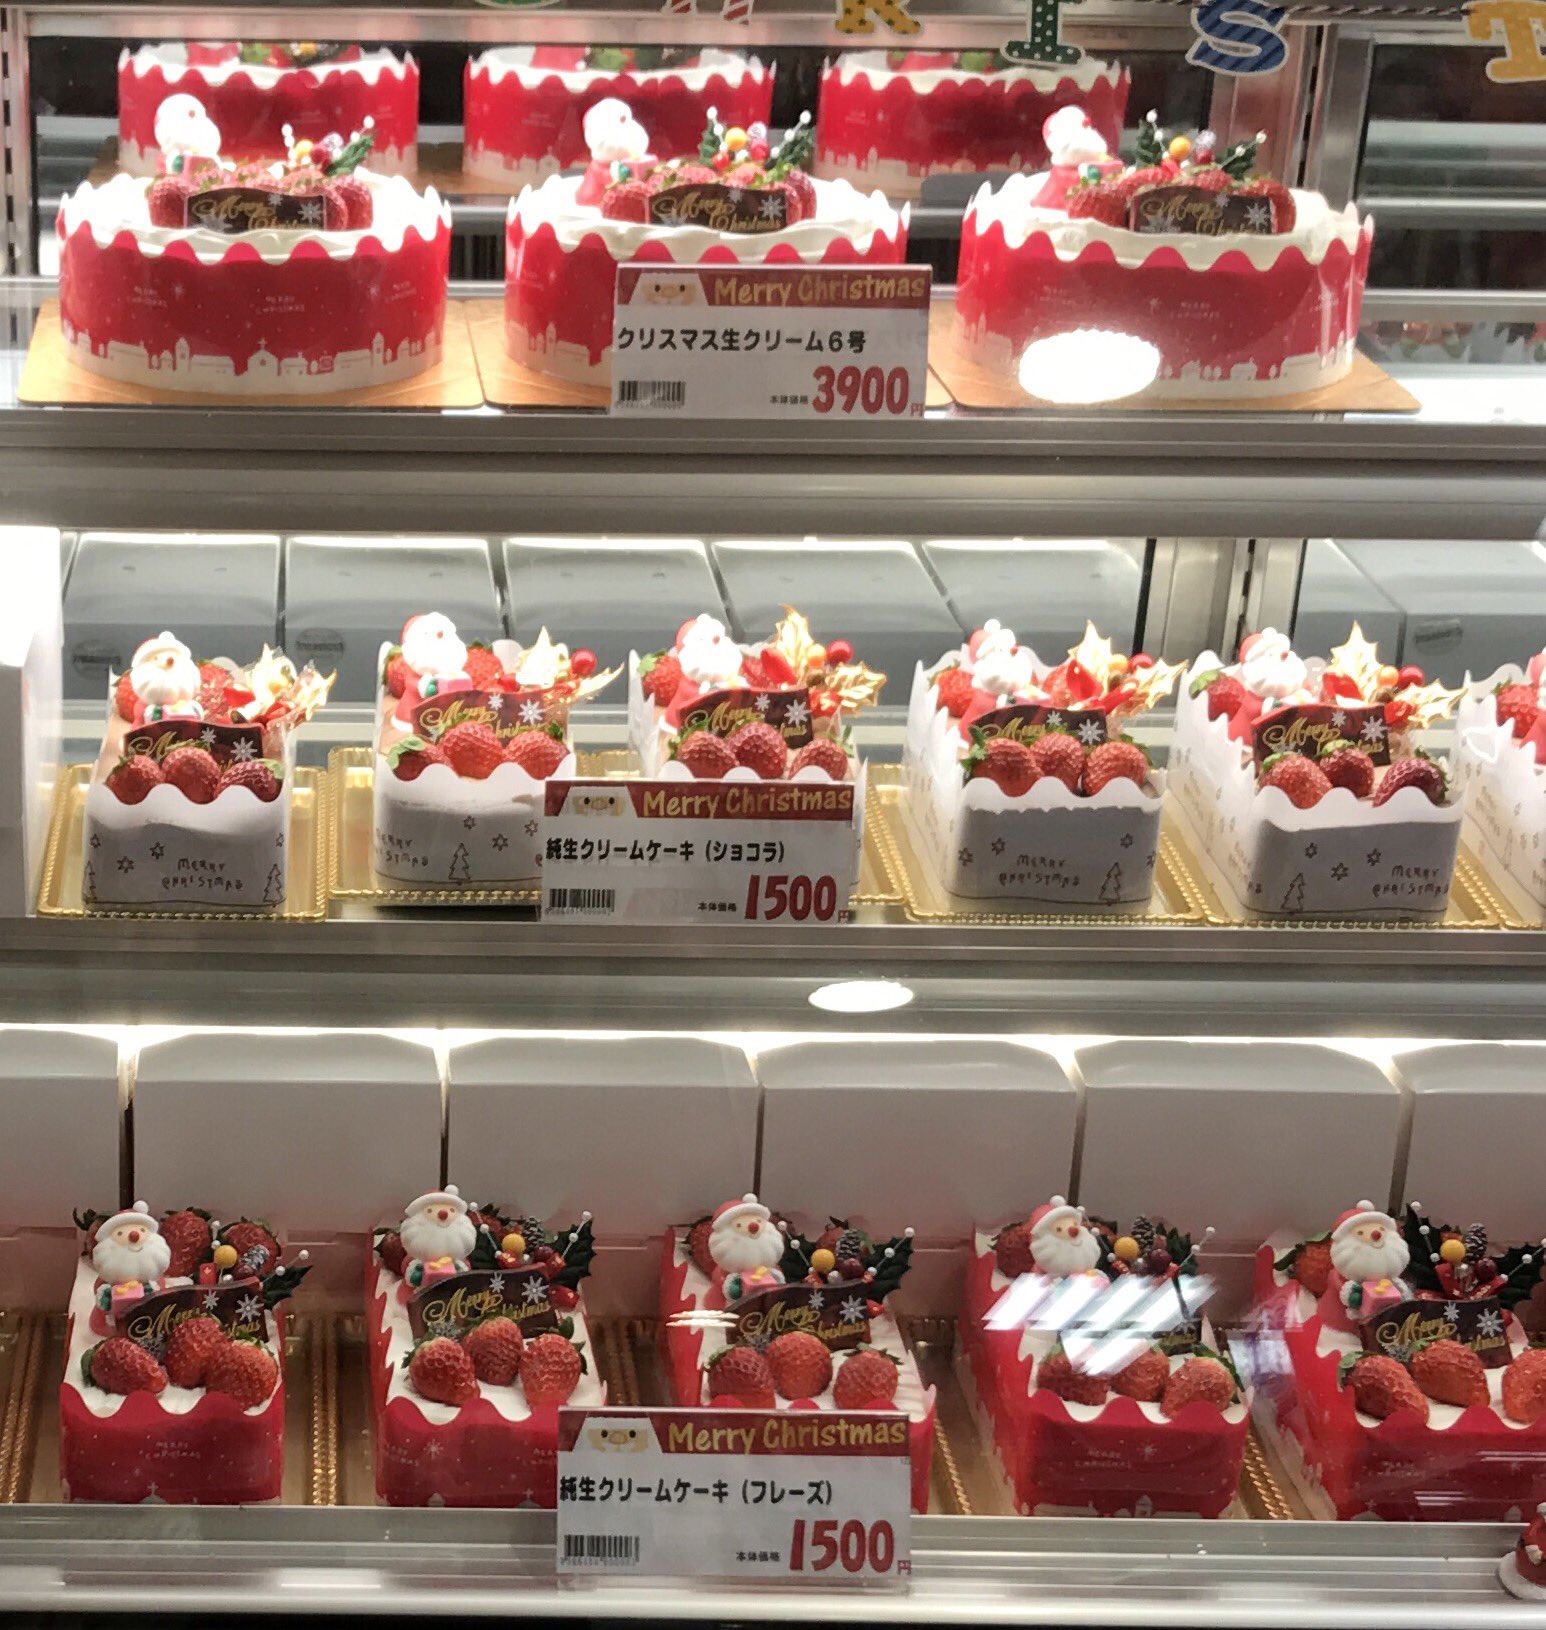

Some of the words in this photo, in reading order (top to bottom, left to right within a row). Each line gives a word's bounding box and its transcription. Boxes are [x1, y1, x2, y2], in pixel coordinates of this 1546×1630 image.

[714, 277, 793, 306] Merry
[799, 274, 926, 300] Christmas
[617, 327, 866, 353] クリスマス生クリーム6号
[812, 365, 909, 414] 3900
[643, 790, 720, 819] Merry
[726, 787, 851, 815] Christmas
[744, 875, 837, 921] 1500
[422, 1287, 503, 1322] Merry
[739, 1301, 820, 1335] Merry
[669, 1422, 756, 1454] Merry
[763, 1418, 906, 1448] Christmas
[789, 1519, 894, 1573] 1500
